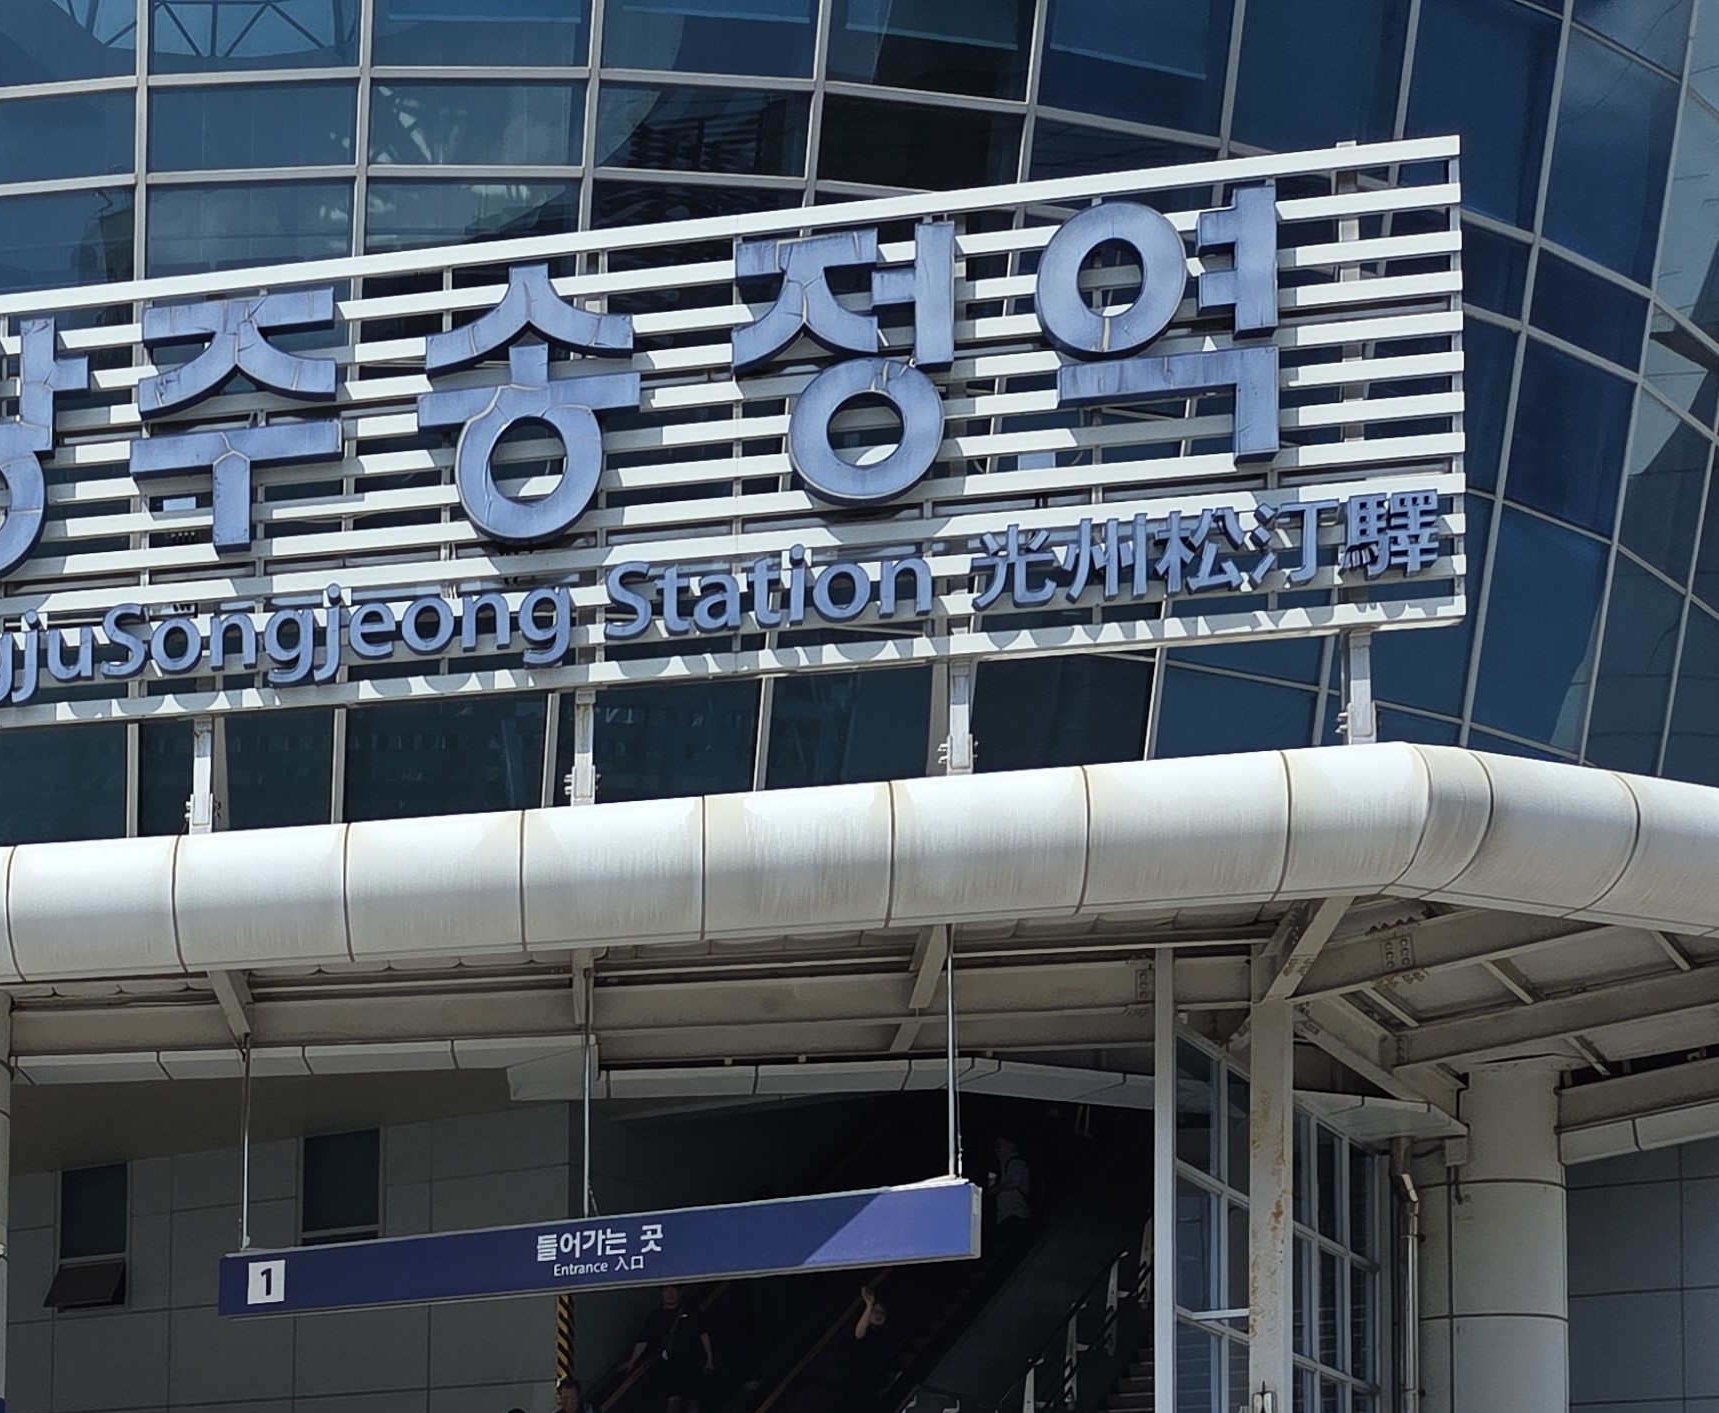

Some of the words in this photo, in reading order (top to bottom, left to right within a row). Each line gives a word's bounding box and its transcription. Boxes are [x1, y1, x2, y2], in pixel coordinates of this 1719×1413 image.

[604, 543, 933, 641] Station
[972, 487, 1442, 613] 光州松汀驛
[535, 1226, 627, 1263] 들어가는
[640, 1223, 664, 1254] 곳
[258, 1267, 274, 1297] 1
[553, 1262, 609, 1277] Entrance
[614, 1256, 645, 1271] 入口
